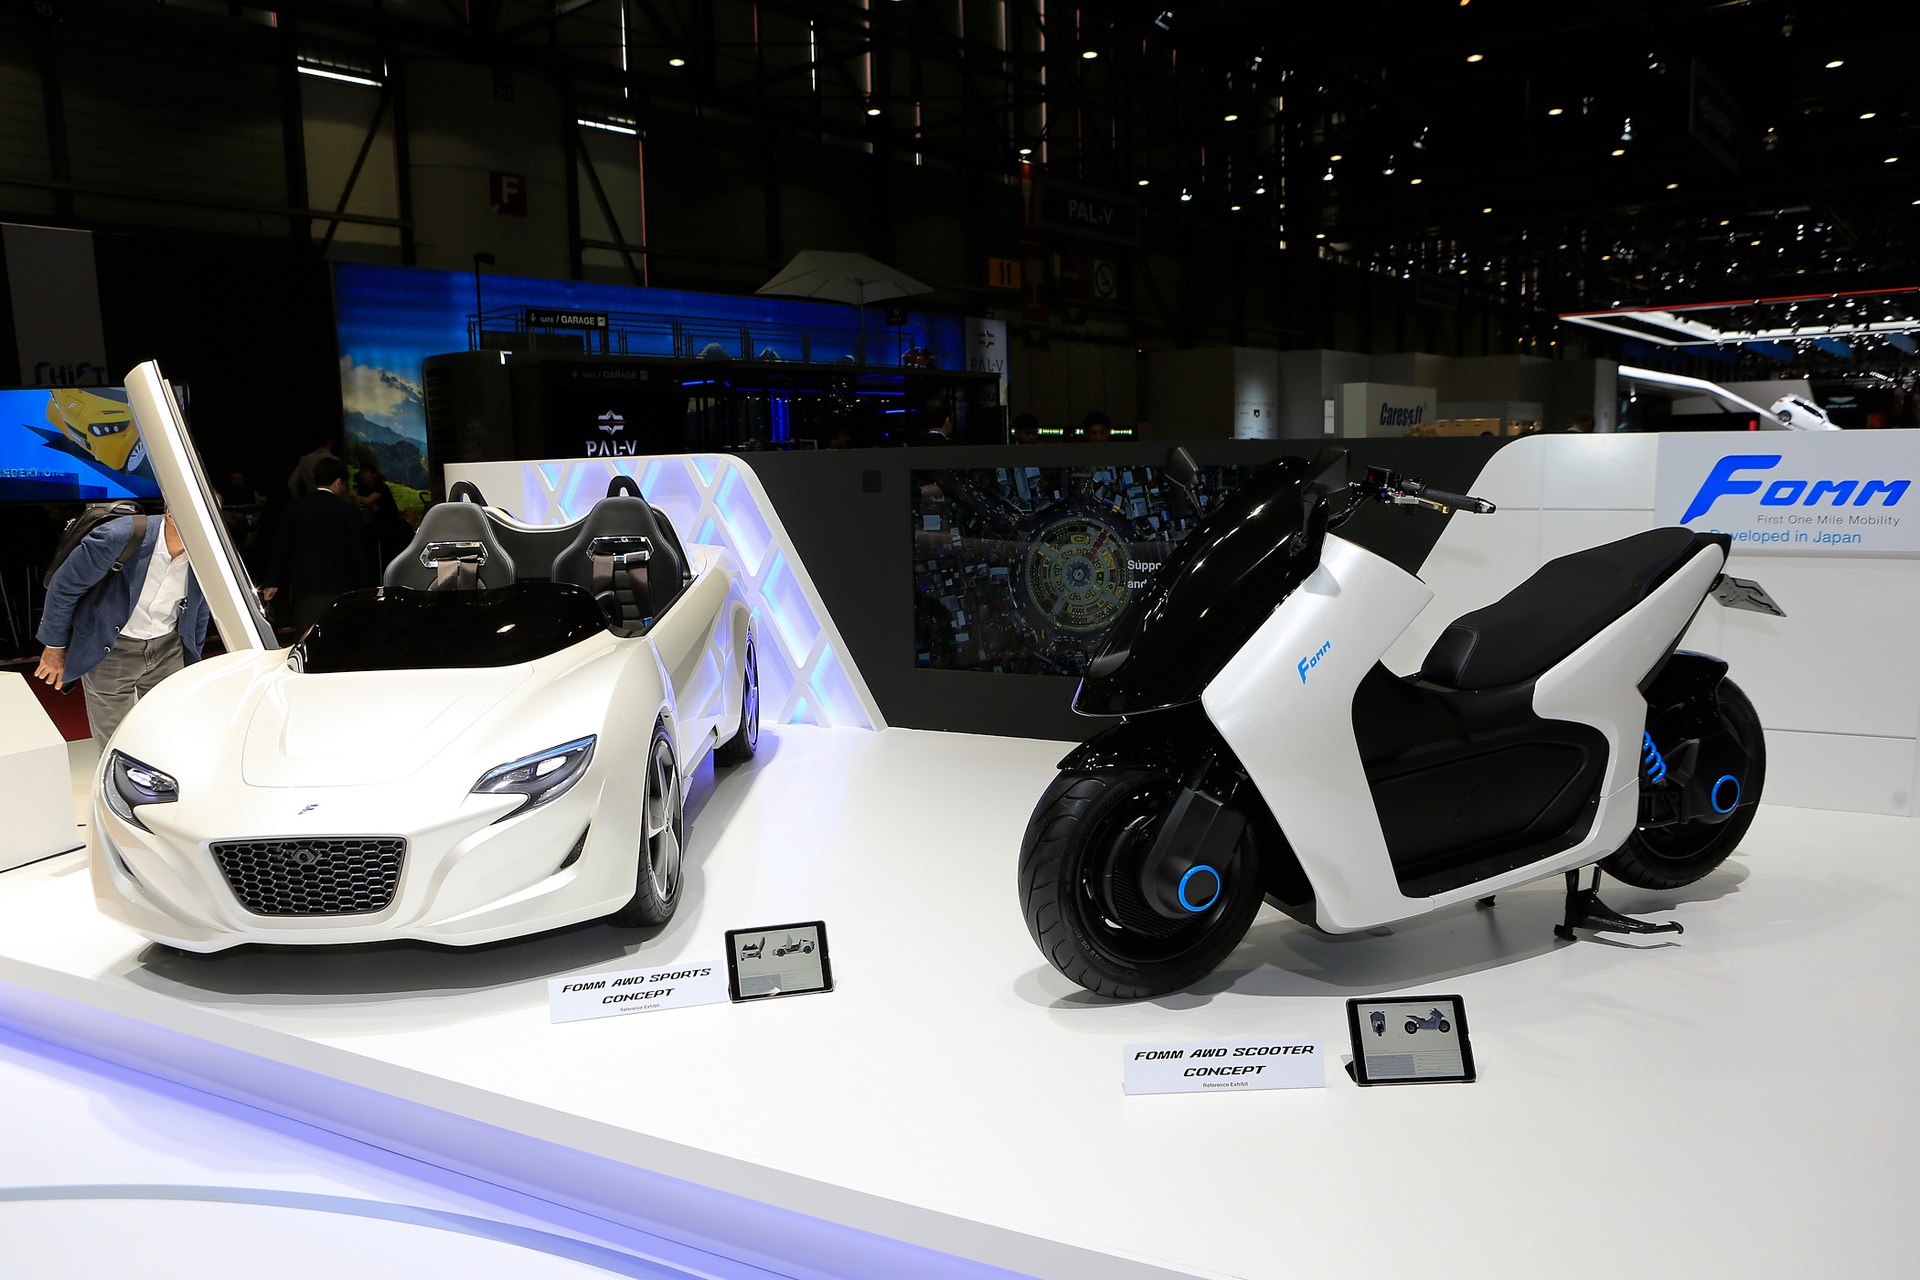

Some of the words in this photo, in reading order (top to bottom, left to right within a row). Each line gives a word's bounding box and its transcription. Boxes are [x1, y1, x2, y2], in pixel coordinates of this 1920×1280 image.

[502, 176, 519, 204] F
[1068, 198, 1113, 226] PAL-V
[1000, 262, 1012, 285] 11
[561, 315, 595, 325] GARAGE
[586, 439, 638, 457] PAL-V
[1757, 514, 1783, 525] First
[1788, 515, 1812, 525] One
[1817, 515, 1844, 526] Mile
[1849, 515, 1900, 527] Mobility
[1711, 528, 1789, 543] veloped
[1795, 530, 1808, 543] in
[1813, 530, 1861, 545] Japan
[562, 981, 606, 993] FOMM
[611, 976, 644, 987] AWD
[649, 968, 711, 983] SPORTS
[602, 988, 675, 1004] CONCEPT
[1134, 1050, 1184, 1061] FOMM
[1189, 1048, 1228, 1058] AWD
[1232, 1045, 1315, 1057] SCOOTER
[1183, 1065, 1267, 1077] CONCEPT
